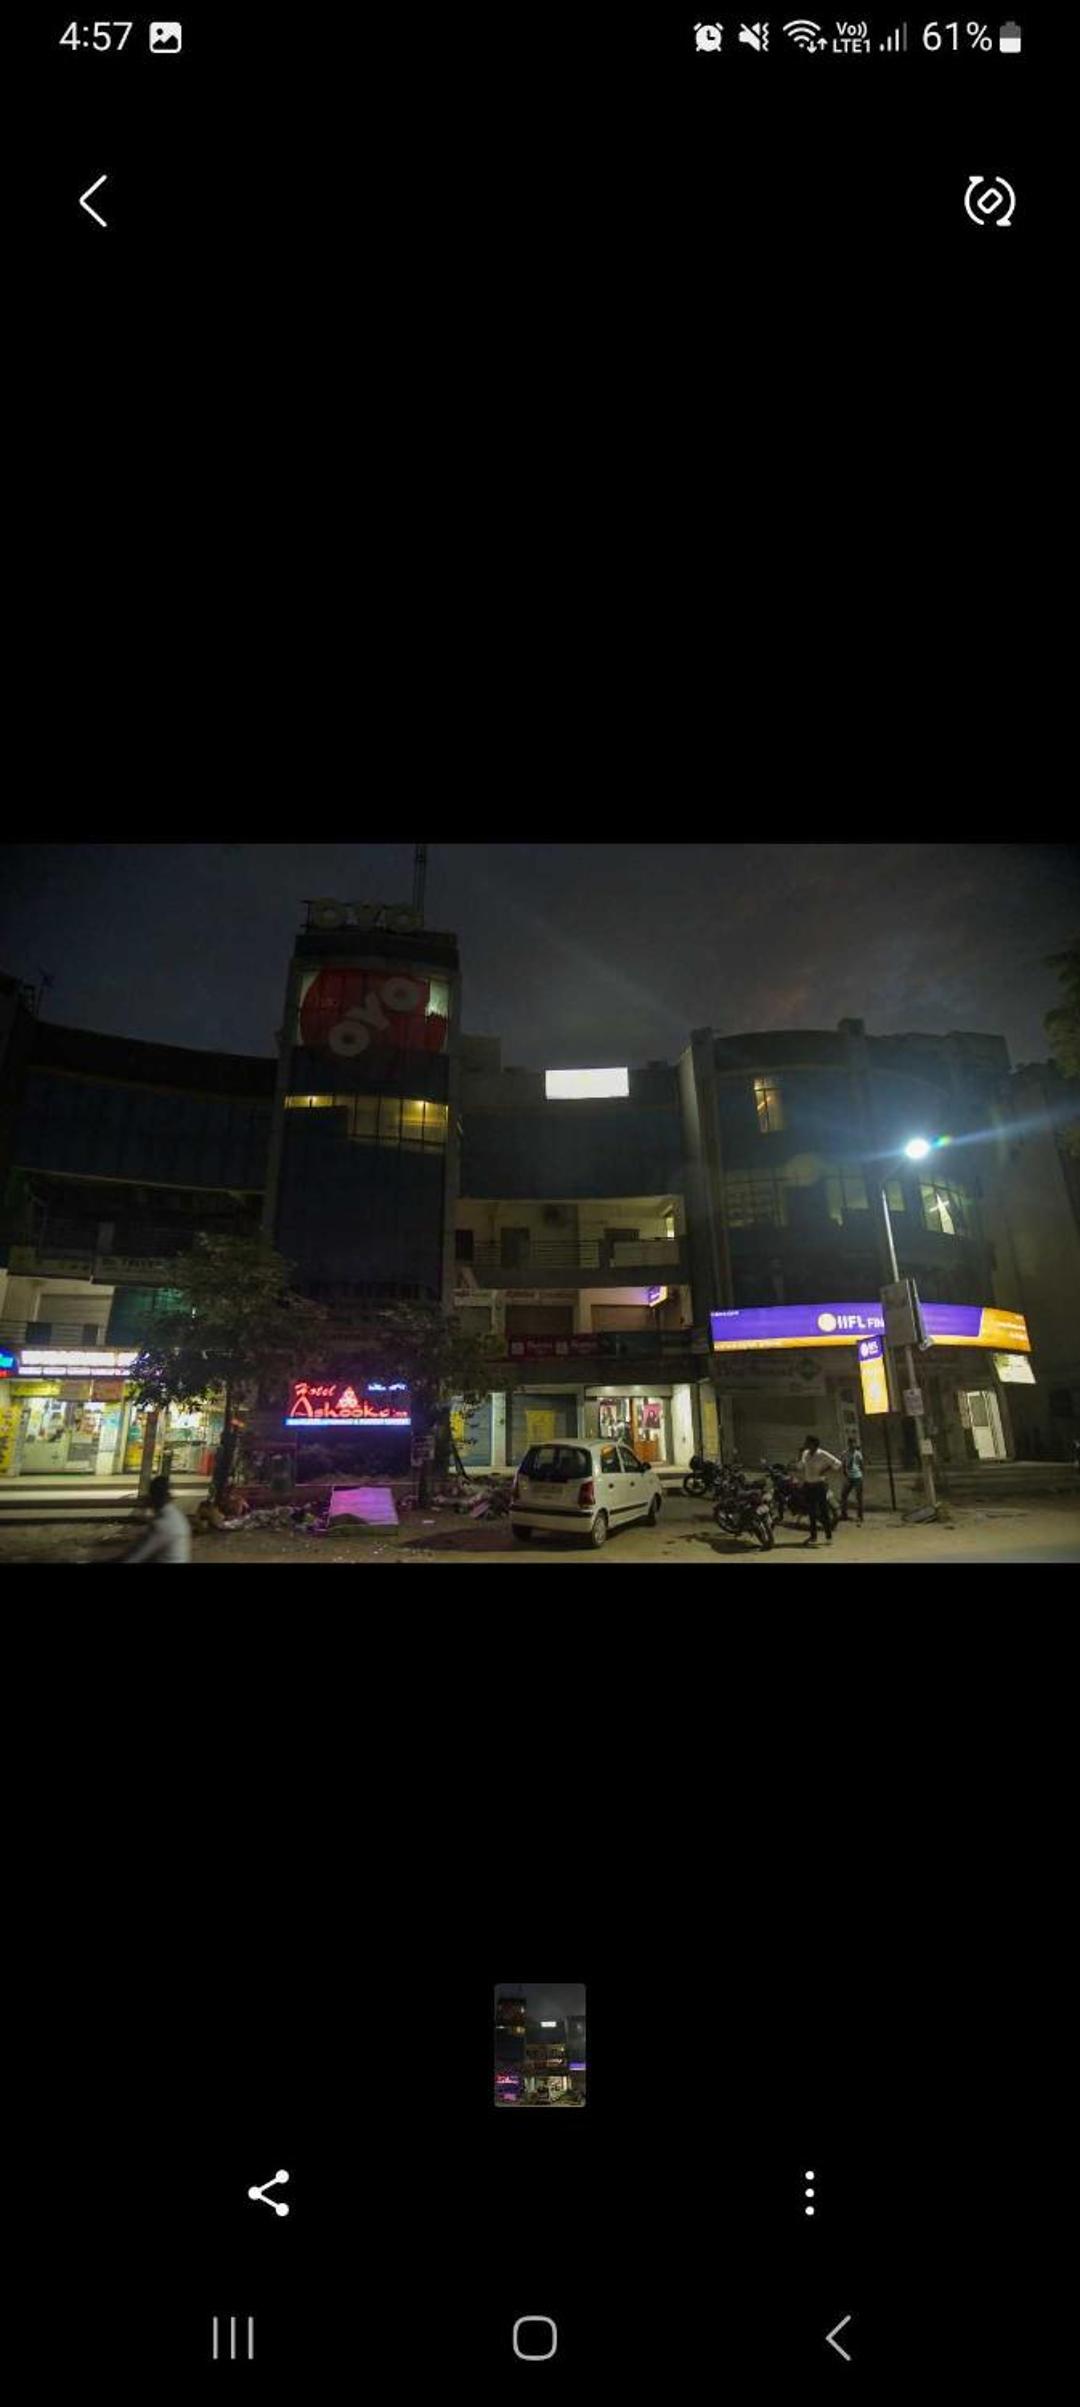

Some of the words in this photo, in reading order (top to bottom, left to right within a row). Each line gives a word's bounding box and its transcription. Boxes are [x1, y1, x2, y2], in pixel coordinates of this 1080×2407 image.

[328, 976, 421, 1058] OYO
[837, 1315, 866, 1329] IIFL
[295, 1382, 336, 1397] Hotel
